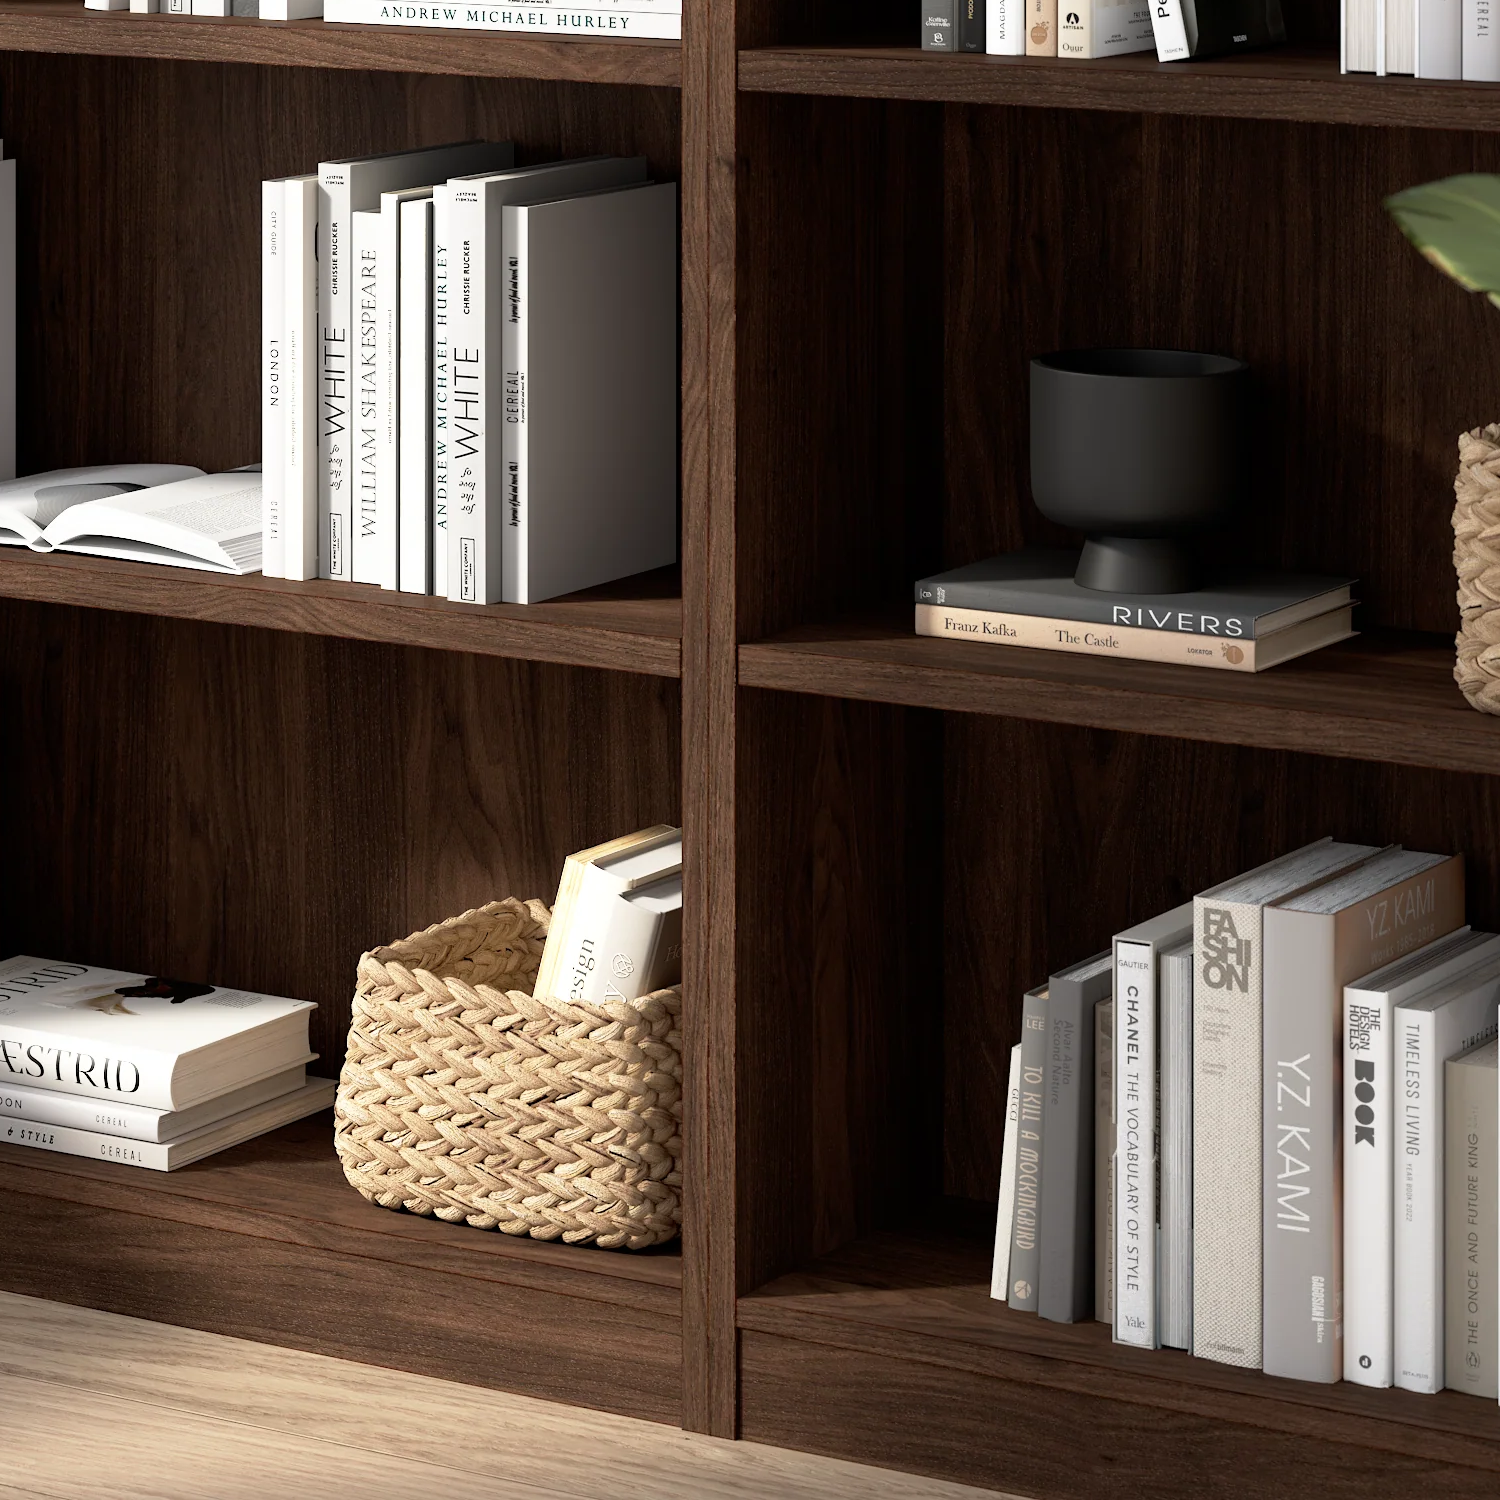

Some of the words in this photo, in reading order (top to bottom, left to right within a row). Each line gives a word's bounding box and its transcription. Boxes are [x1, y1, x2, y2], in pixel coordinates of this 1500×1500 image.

[380, 6, 457, 21] ANDREW
[466, 9, 548, 25] MICHAEL
[557, 14, 630, 29] HURLEY
[437, 245, 447, 325] HURLEY
[361, 249, 377, 419] SHAKESPEARE
[270, 340, 279, 406] LONDON
[324, 327, 346, 437] WHITE
[437, 336, 447, 429] MICHAEL
[454, 347, 479, 459] WHITE
[506, 370, 519, 423] CEREAL
[361, 429, 377, 538] WILLIAM
[437, 441, 447, 530] ANDREW
[944, 617, 979, 633] Franz
[982, 622, 1017, 638] Kafka
[1055, 629, 1081, 645] The
[1084, 633, 1120, 649] Castle
[1113, 605, 1243, 637] RIVERS
[1118, 959, 1149, 970] GAUTIER
[1202, 934, 1251, 967] SHI
[1026, 1019, 1045, 1031] LEE
[1053, 1018, 1065, 1056] Second
[1062, 1019, 1074, 1045] Alvar
[1127, 985, 1139, 1065] CHANEL
[1359, 1006, 1371, 1051] DESIGN
[1369, 1007, 1381, 1031] THE
[1023, 1065, 1043, 1085] TO
[1062, 1047, 1073, 1086] Aalto
[1405, 1024, 1420, 1100] TIMELESS
[1051, 1058, 1062, 1106] Nature
[1127, 1073, 1139, 1102] THE
[1277, 1053, 1311, 1112] Y.Z.
[95, 1114, 128, 1129] CEREAL
[1022, 1091, 1042, 1122] KILL
[1354, 1059, 1375, 1148] BOOK
[7, 1126, 14, 1137] &
[21, 1129, 56, 1145] STYLE
[1021, 1128, 1040, 1141] A
[1405, 1105, 1420, 1156] LIVING
[100, 1144, 143, 1163] CEREAL
[1126, 1106, 1139, 1213] VOCABULARY
[1467, 1132, 1479, 1169] KING
[1276, 1124, 1311, 1233] KAMI
[1405, 1163, 1413, 1181] YEAR
[1016, 1148, 1039, 1251] MOCKINGBIRD
[1405, 1183, 1413, 1202] BOOK
[1467, 1174, 1479, 1226] FUTURE
[1127, 1218, 1139, 1240] OF
[1405, 1203, 1413, 1222] 2022
[1467, 1231, 1479, 1265] AND
[1127, 1244, 1139, 1292] STYLE
[1467, 1268, 1479, 1314] ONCE
[1124, 1315, 1146, 1329] Yale
[1467, 1319, 1479, 1346] THE
